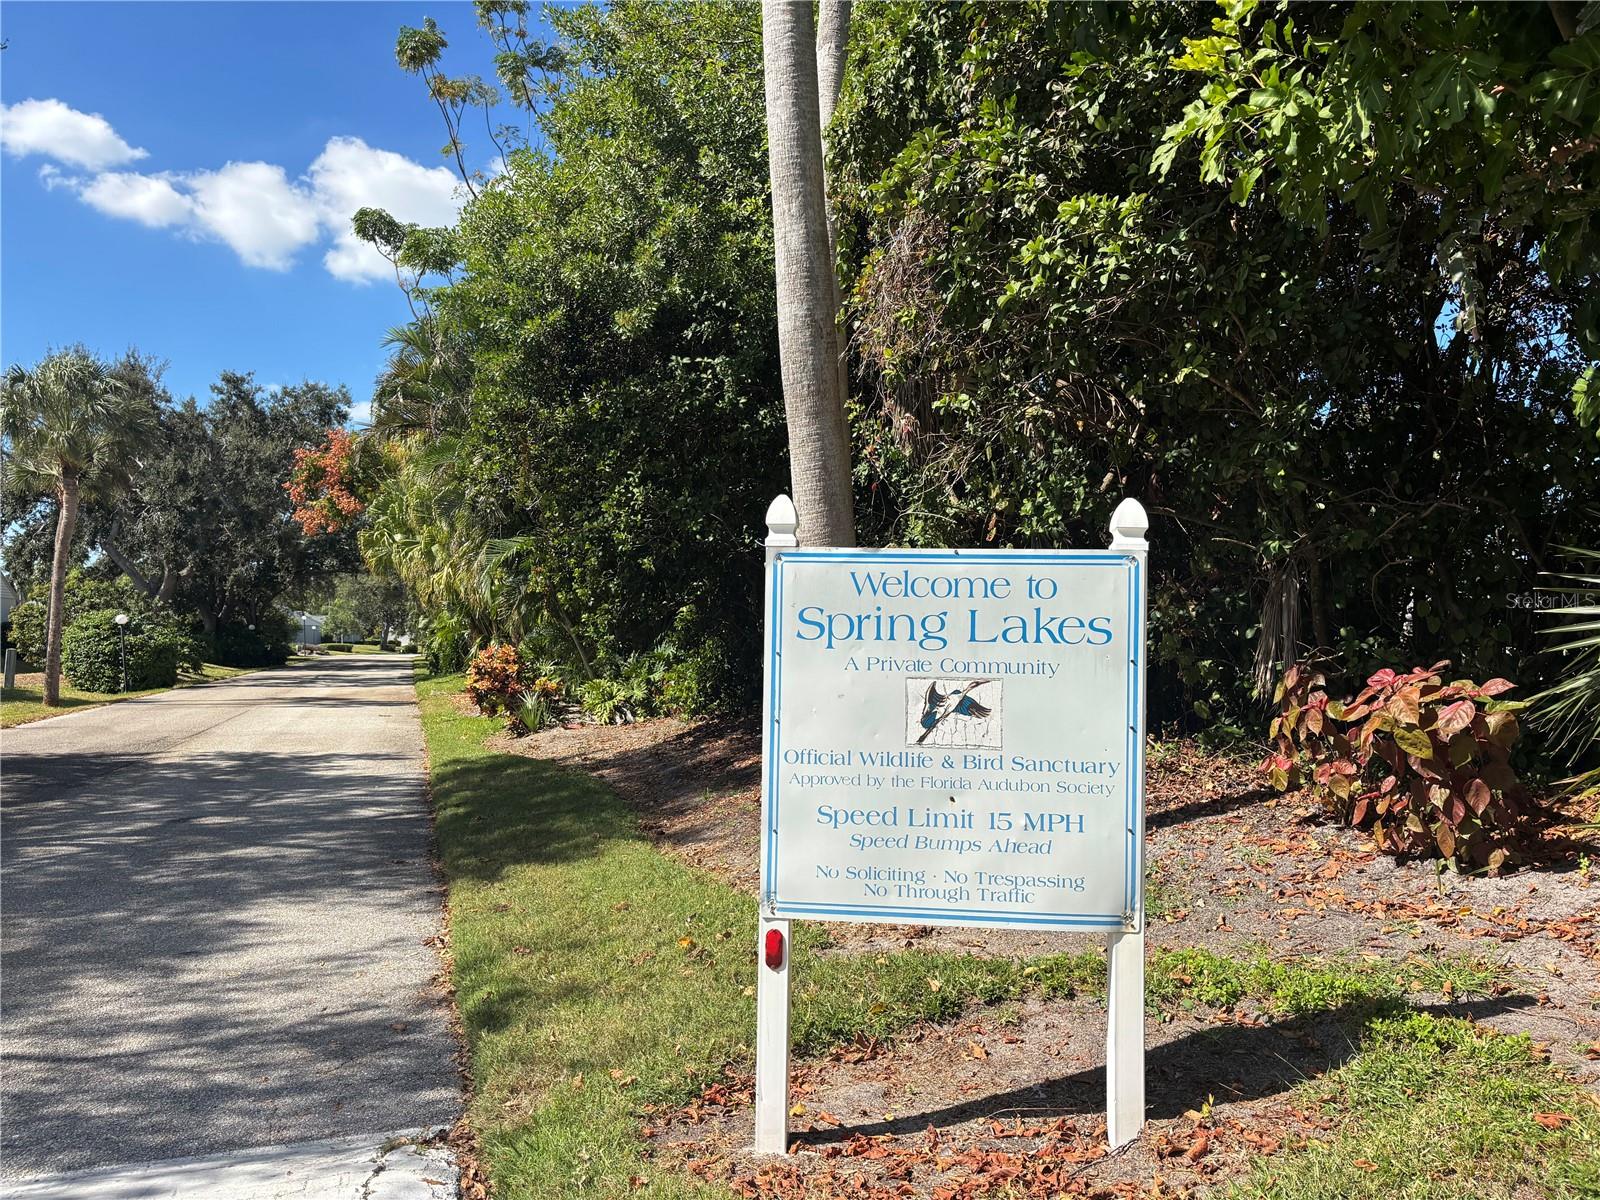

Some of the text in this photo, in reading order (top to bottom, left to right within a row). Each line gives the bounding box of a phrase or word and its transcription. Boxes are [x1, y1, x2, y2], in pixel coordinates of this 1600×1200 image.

[850, 570, 1058, 600] Welcome to
[796, 606, 1113, 651] Spring Lakes
[844, 656, 1060, 678] A Private Community
[783, 748, 1121, 778] Official Wildlife & Bird Sanctuary
[789, 772, 1115, 798] Approved by the Florida Audubon Society
[816, 804, 1086, 833] Speed Limit 15 MPH
[849, 833, 1053, 855] Speed Bumps Ahead
[815, 864, 1085, 892] No Soliciting No Trespassing
[864, 883, 1035, 904] No Through Traffic
